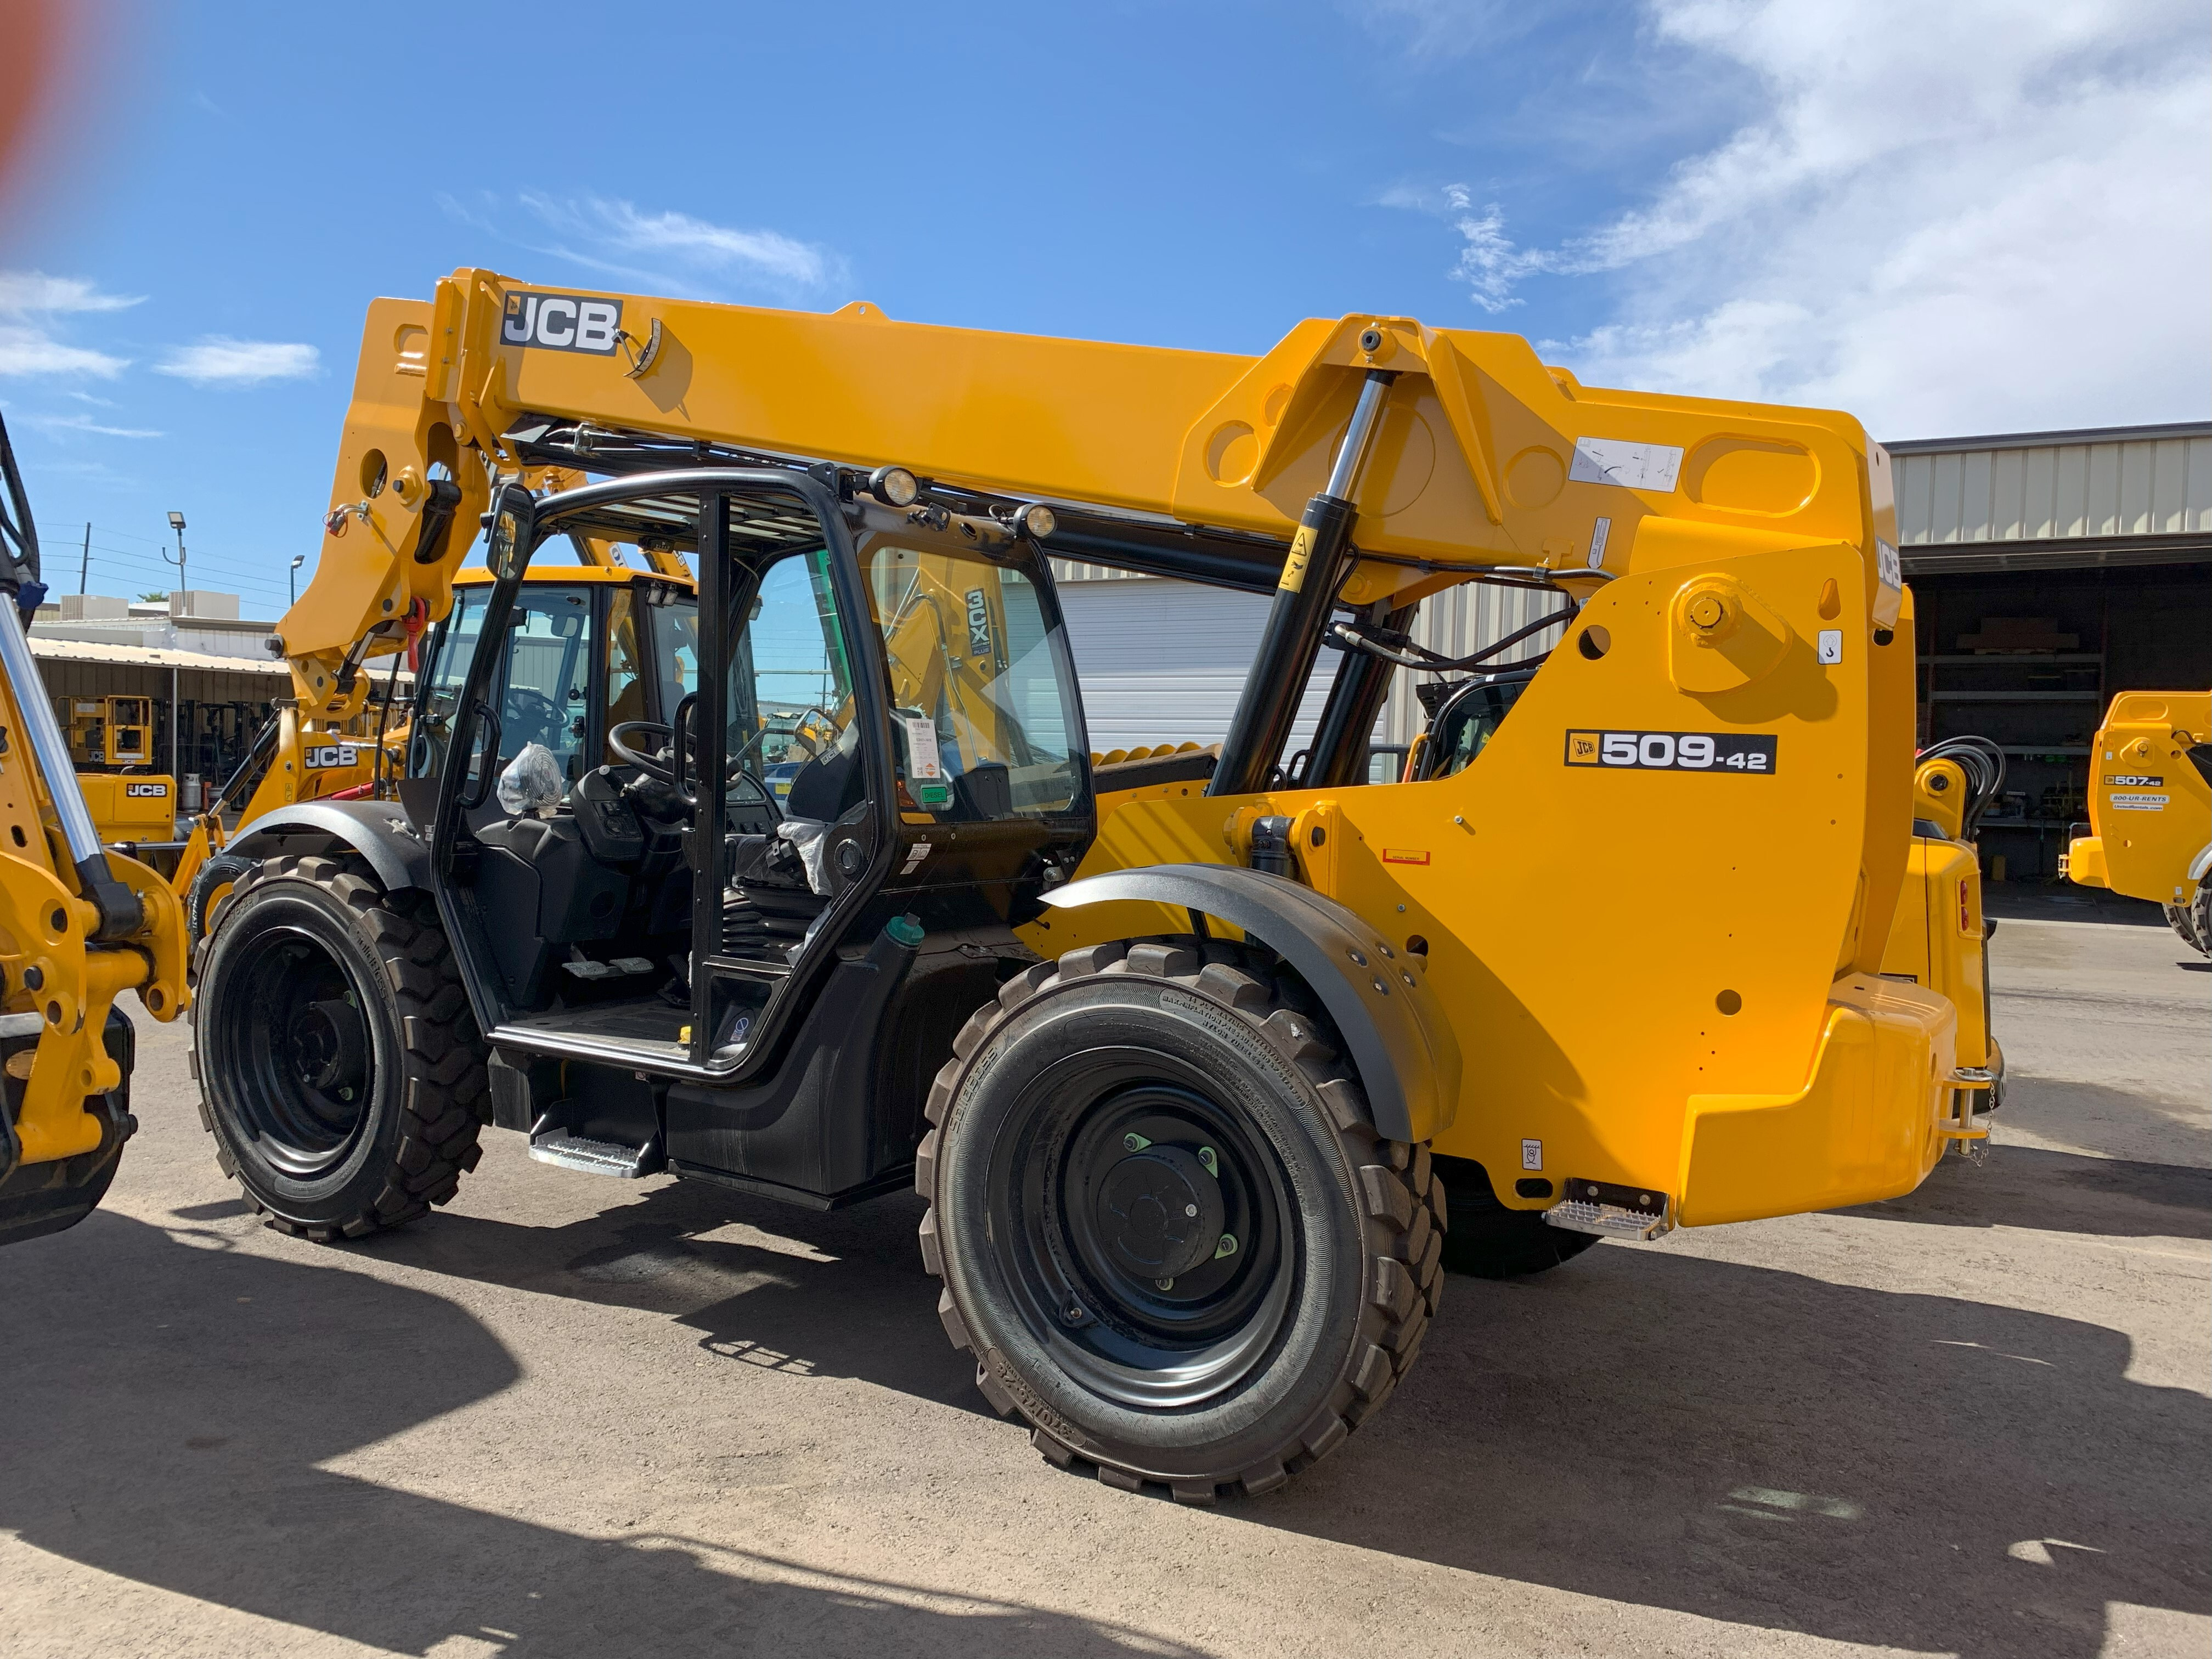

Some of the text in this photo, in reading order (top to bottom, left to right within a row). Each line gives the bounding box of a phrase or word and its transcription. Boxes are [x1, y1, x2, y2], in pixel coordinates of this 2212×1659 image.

[505, 297, 617, 350] JCB
[1877, 540, 1901, 589] JCB
[968, 591, 989, 644] 3CX
[89, 751, 104, 762] JCB
[306, 747, 357, 767] JCB
[1577, 733, 1767, 770] JCB 509-42
[128, 785, 166, 795] JCB
[2115, 776, 2161, 786] 507-42
